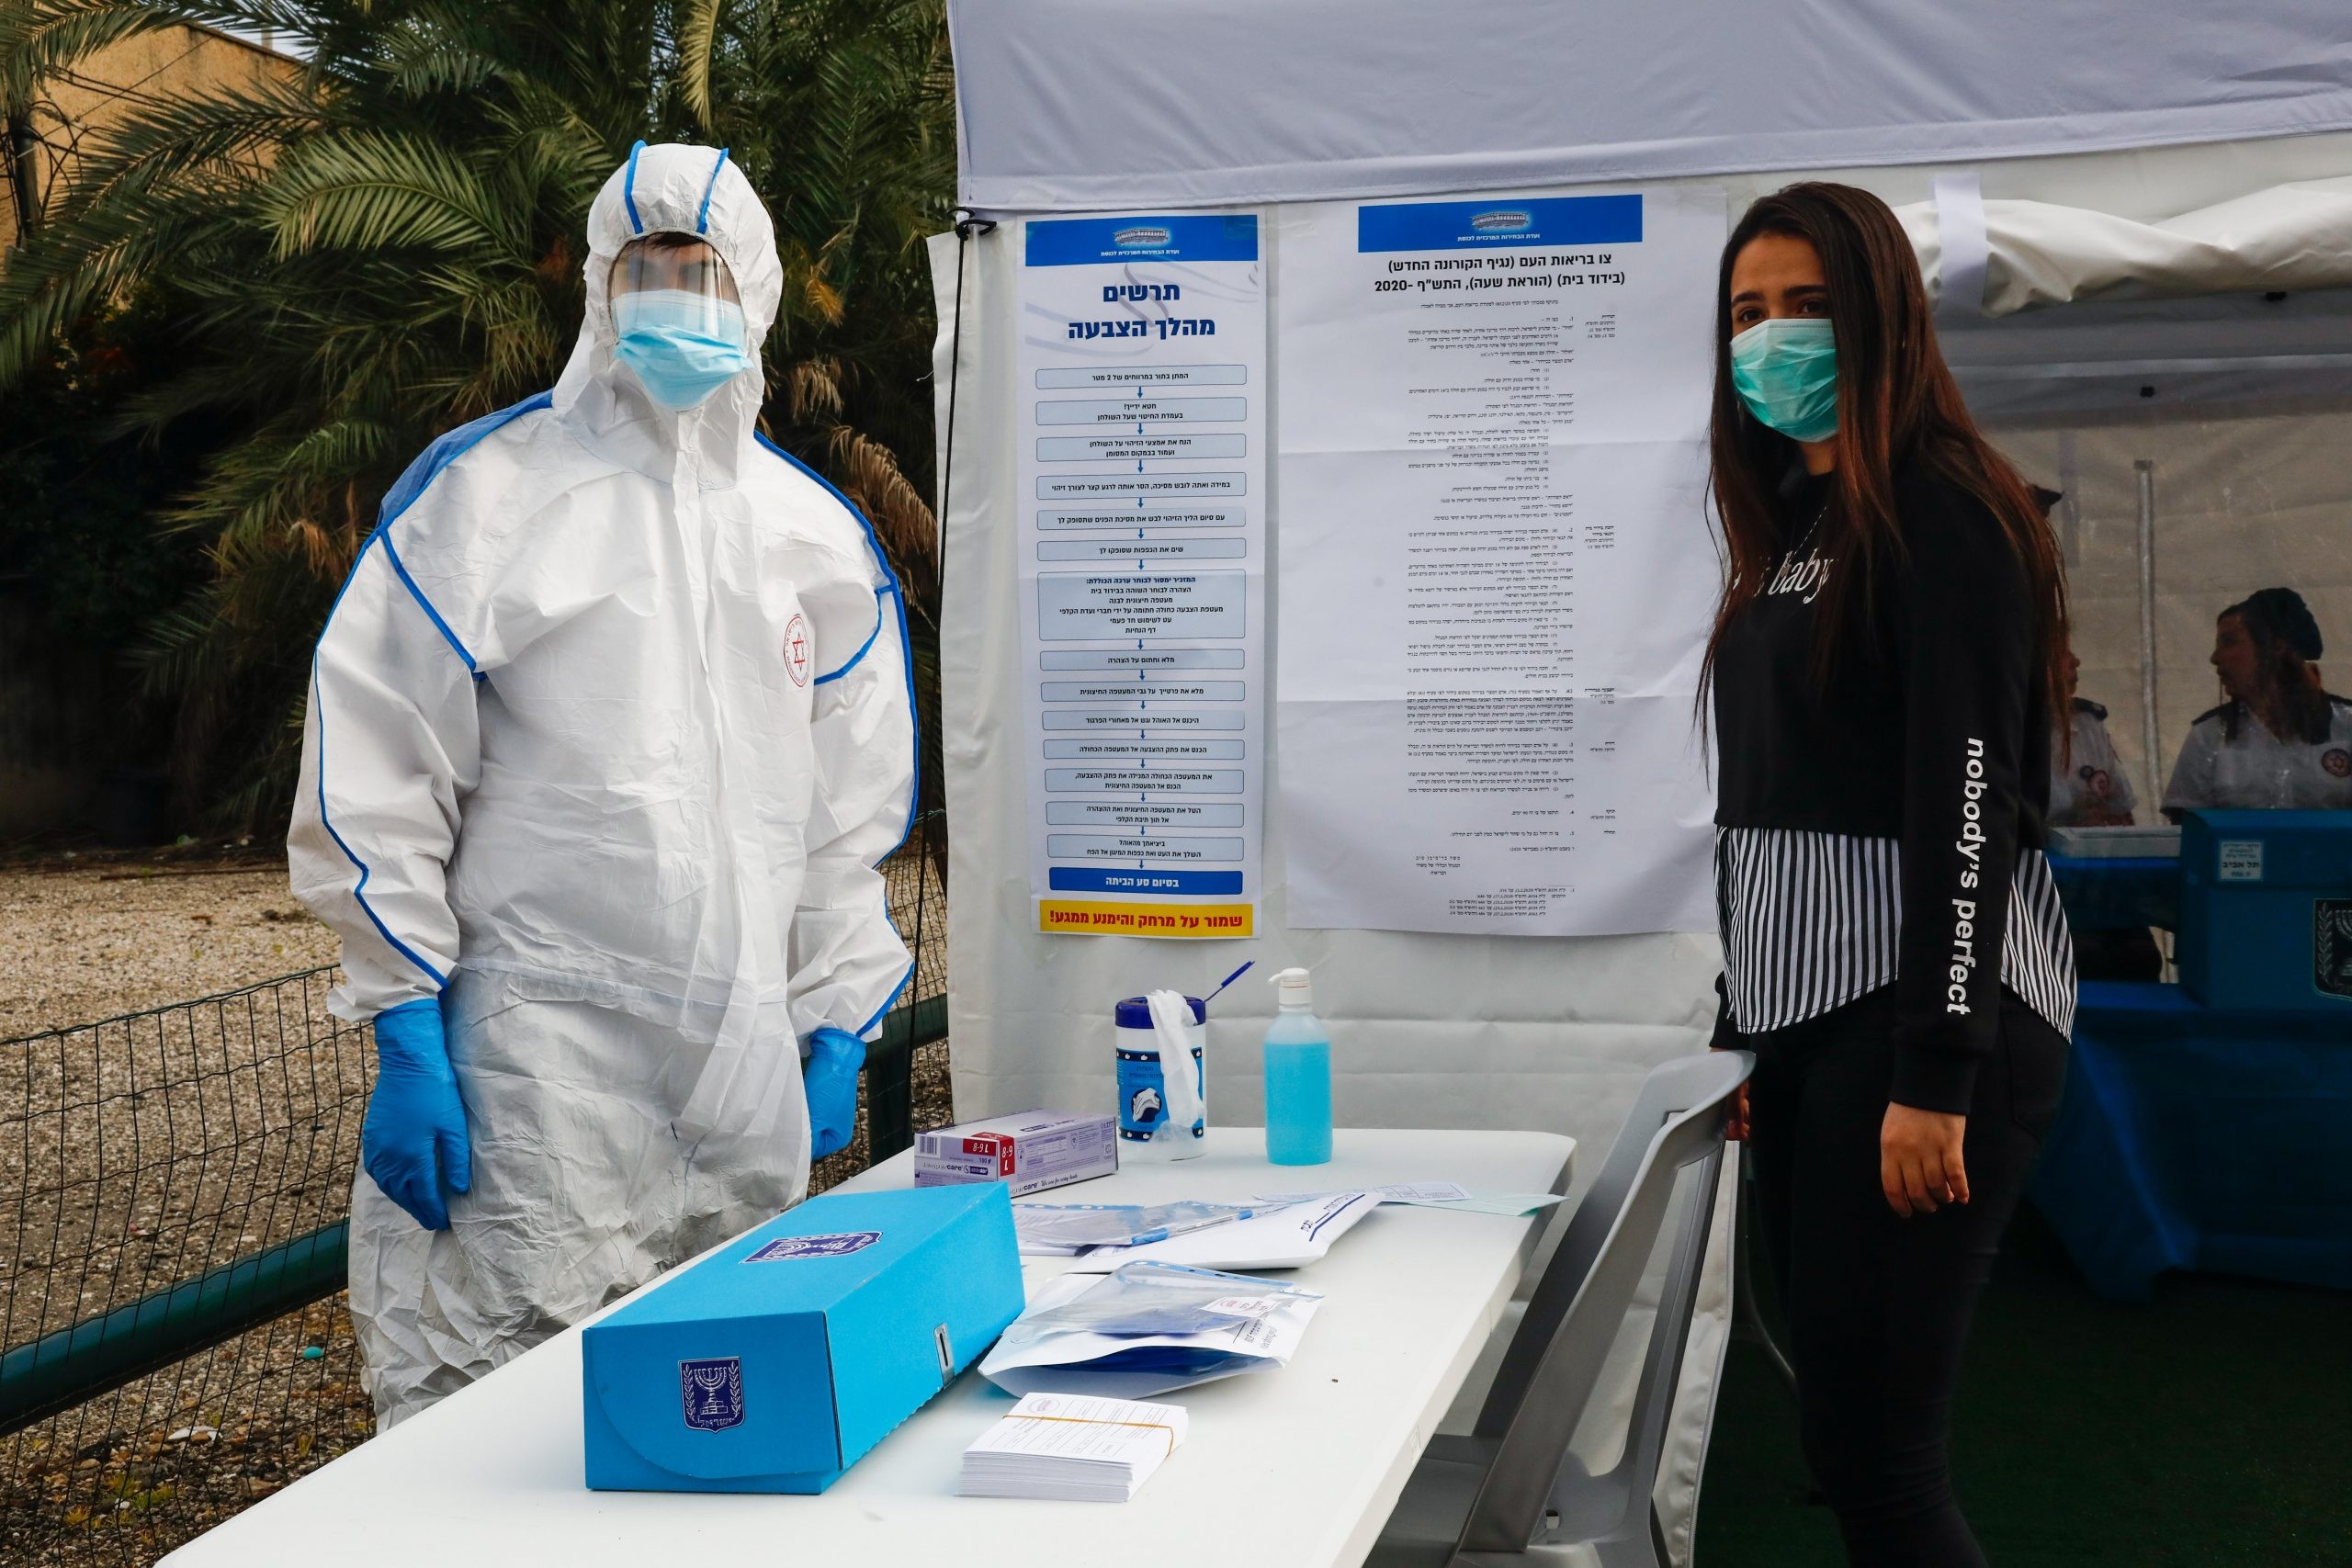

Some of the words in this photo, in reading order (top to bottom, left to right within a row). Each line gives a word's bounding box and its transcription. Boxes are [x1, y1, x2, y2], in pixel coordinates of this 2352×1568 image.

[1434, 259, 1482, 271] הקורונה
[1487, 256, 1515, 270] (נגיף
[1519, 256, 1546, 267] העם
[1550, 255, 1595, 266] בריאות
[1599, 254, 1612, 264] צו
[1388, 260, 1430, 273] החדש)
[1465, 277, 1503, 290] שעה),
[1507, 274, 1552, 288] (הוראת
[1557, 274, 1584, 287] בית)
[1588, 272, 1625, 285] (בידוד
[1103, 284, 1180, 302] תרשים
[1068, 320, 1147, 339] הצבעה
[1154, 318, 1215, 340] מהלך
[1768, 547, 1838, 604] baby
[1956, 737, 1988, 889] nobody's
[1105, 877, 1134, 886] הביתה
[1136, 878, 1150, 887] סע
[1152, 879, 1179, 887] בסיום
[1050, 910, 1089, 923] ממגע!
[1093, 913, 1134, 925] והימנע
[1138, 915, 1176, 927] מרחק
[1180, 915, 1199, 928] על
[1204, 916, 1243, 927] שמור
[1946, 898, 1976, 1015] perfect
[972, 1142, 984, 1153] 8-9
[984, 1144, 989, 1153] L
[1002, 1145, 1013, 1158] 8-9
